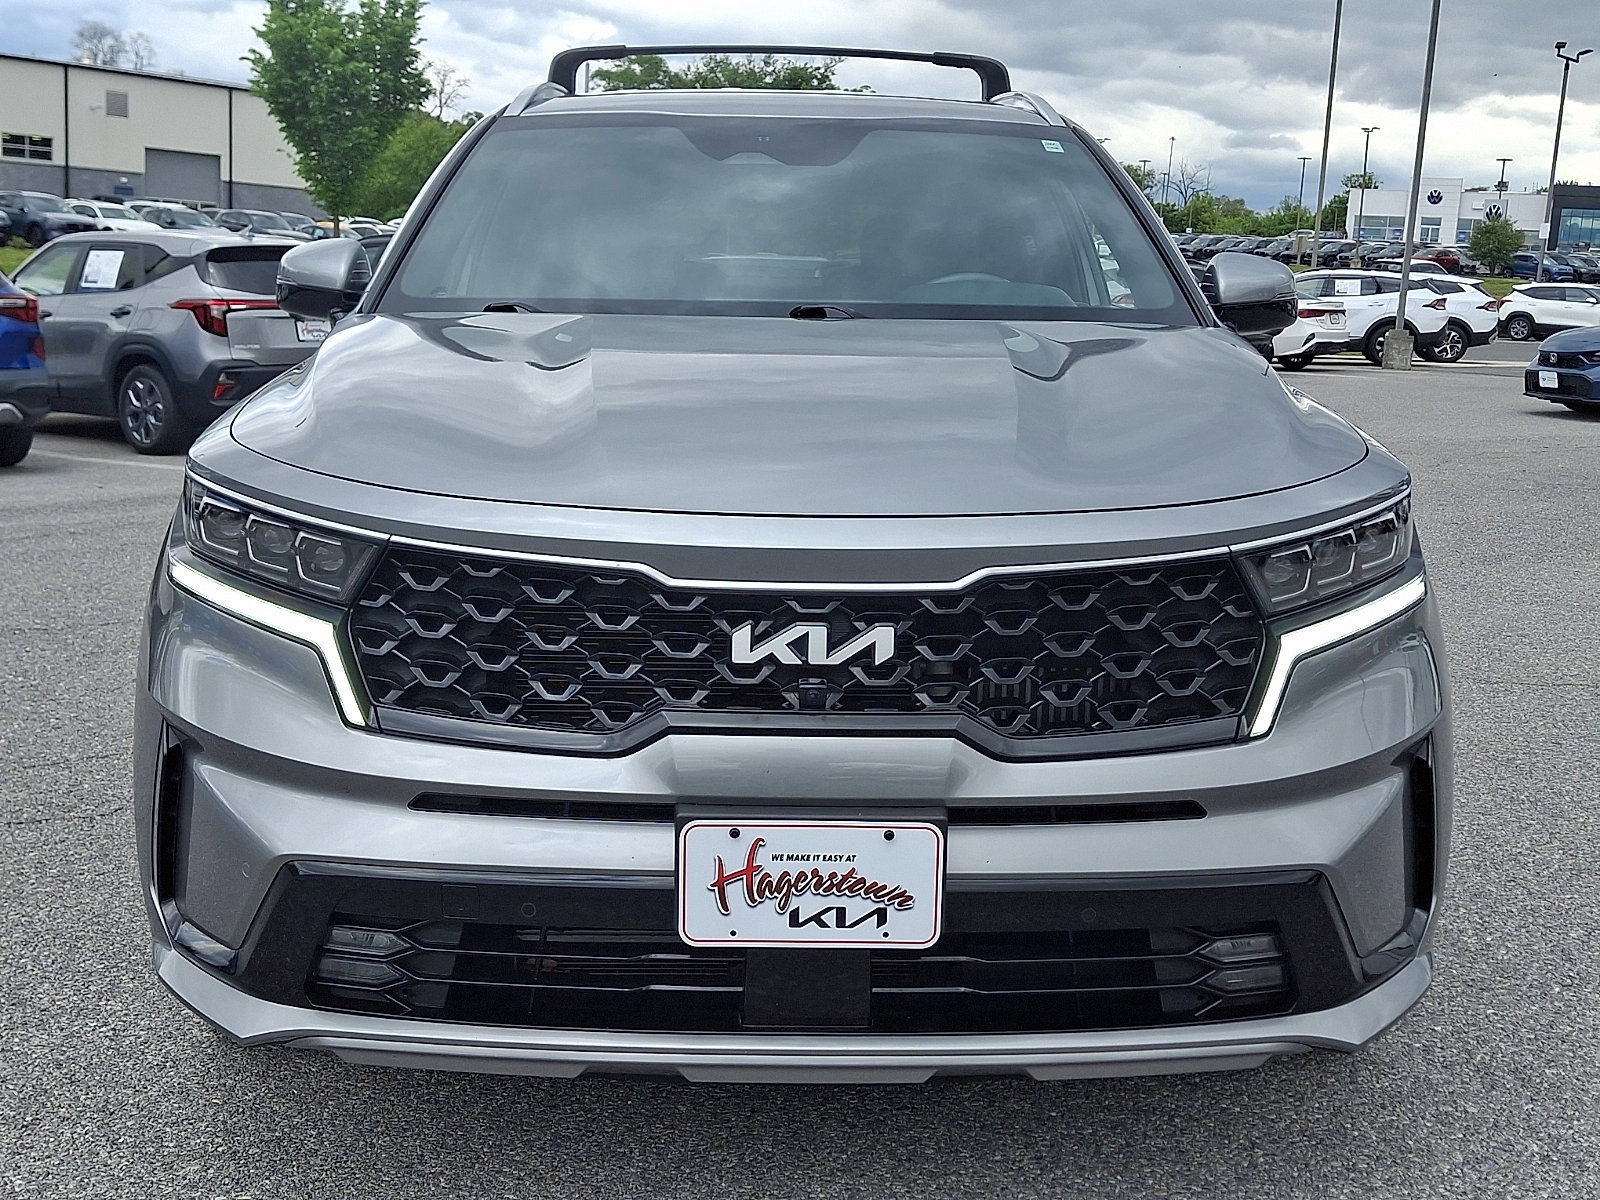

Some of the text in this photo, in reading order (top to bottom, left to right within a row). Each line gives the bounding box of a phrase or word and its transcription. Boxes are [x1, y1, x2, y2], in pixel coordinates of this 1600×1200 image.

[731, 622, 896, 666] KIA
[771, 853, 857, 863] WE MAKE IT EASY AT
[709, 838, 916, 913] Hagerstown
[789, 906, 888, 930] KIA
